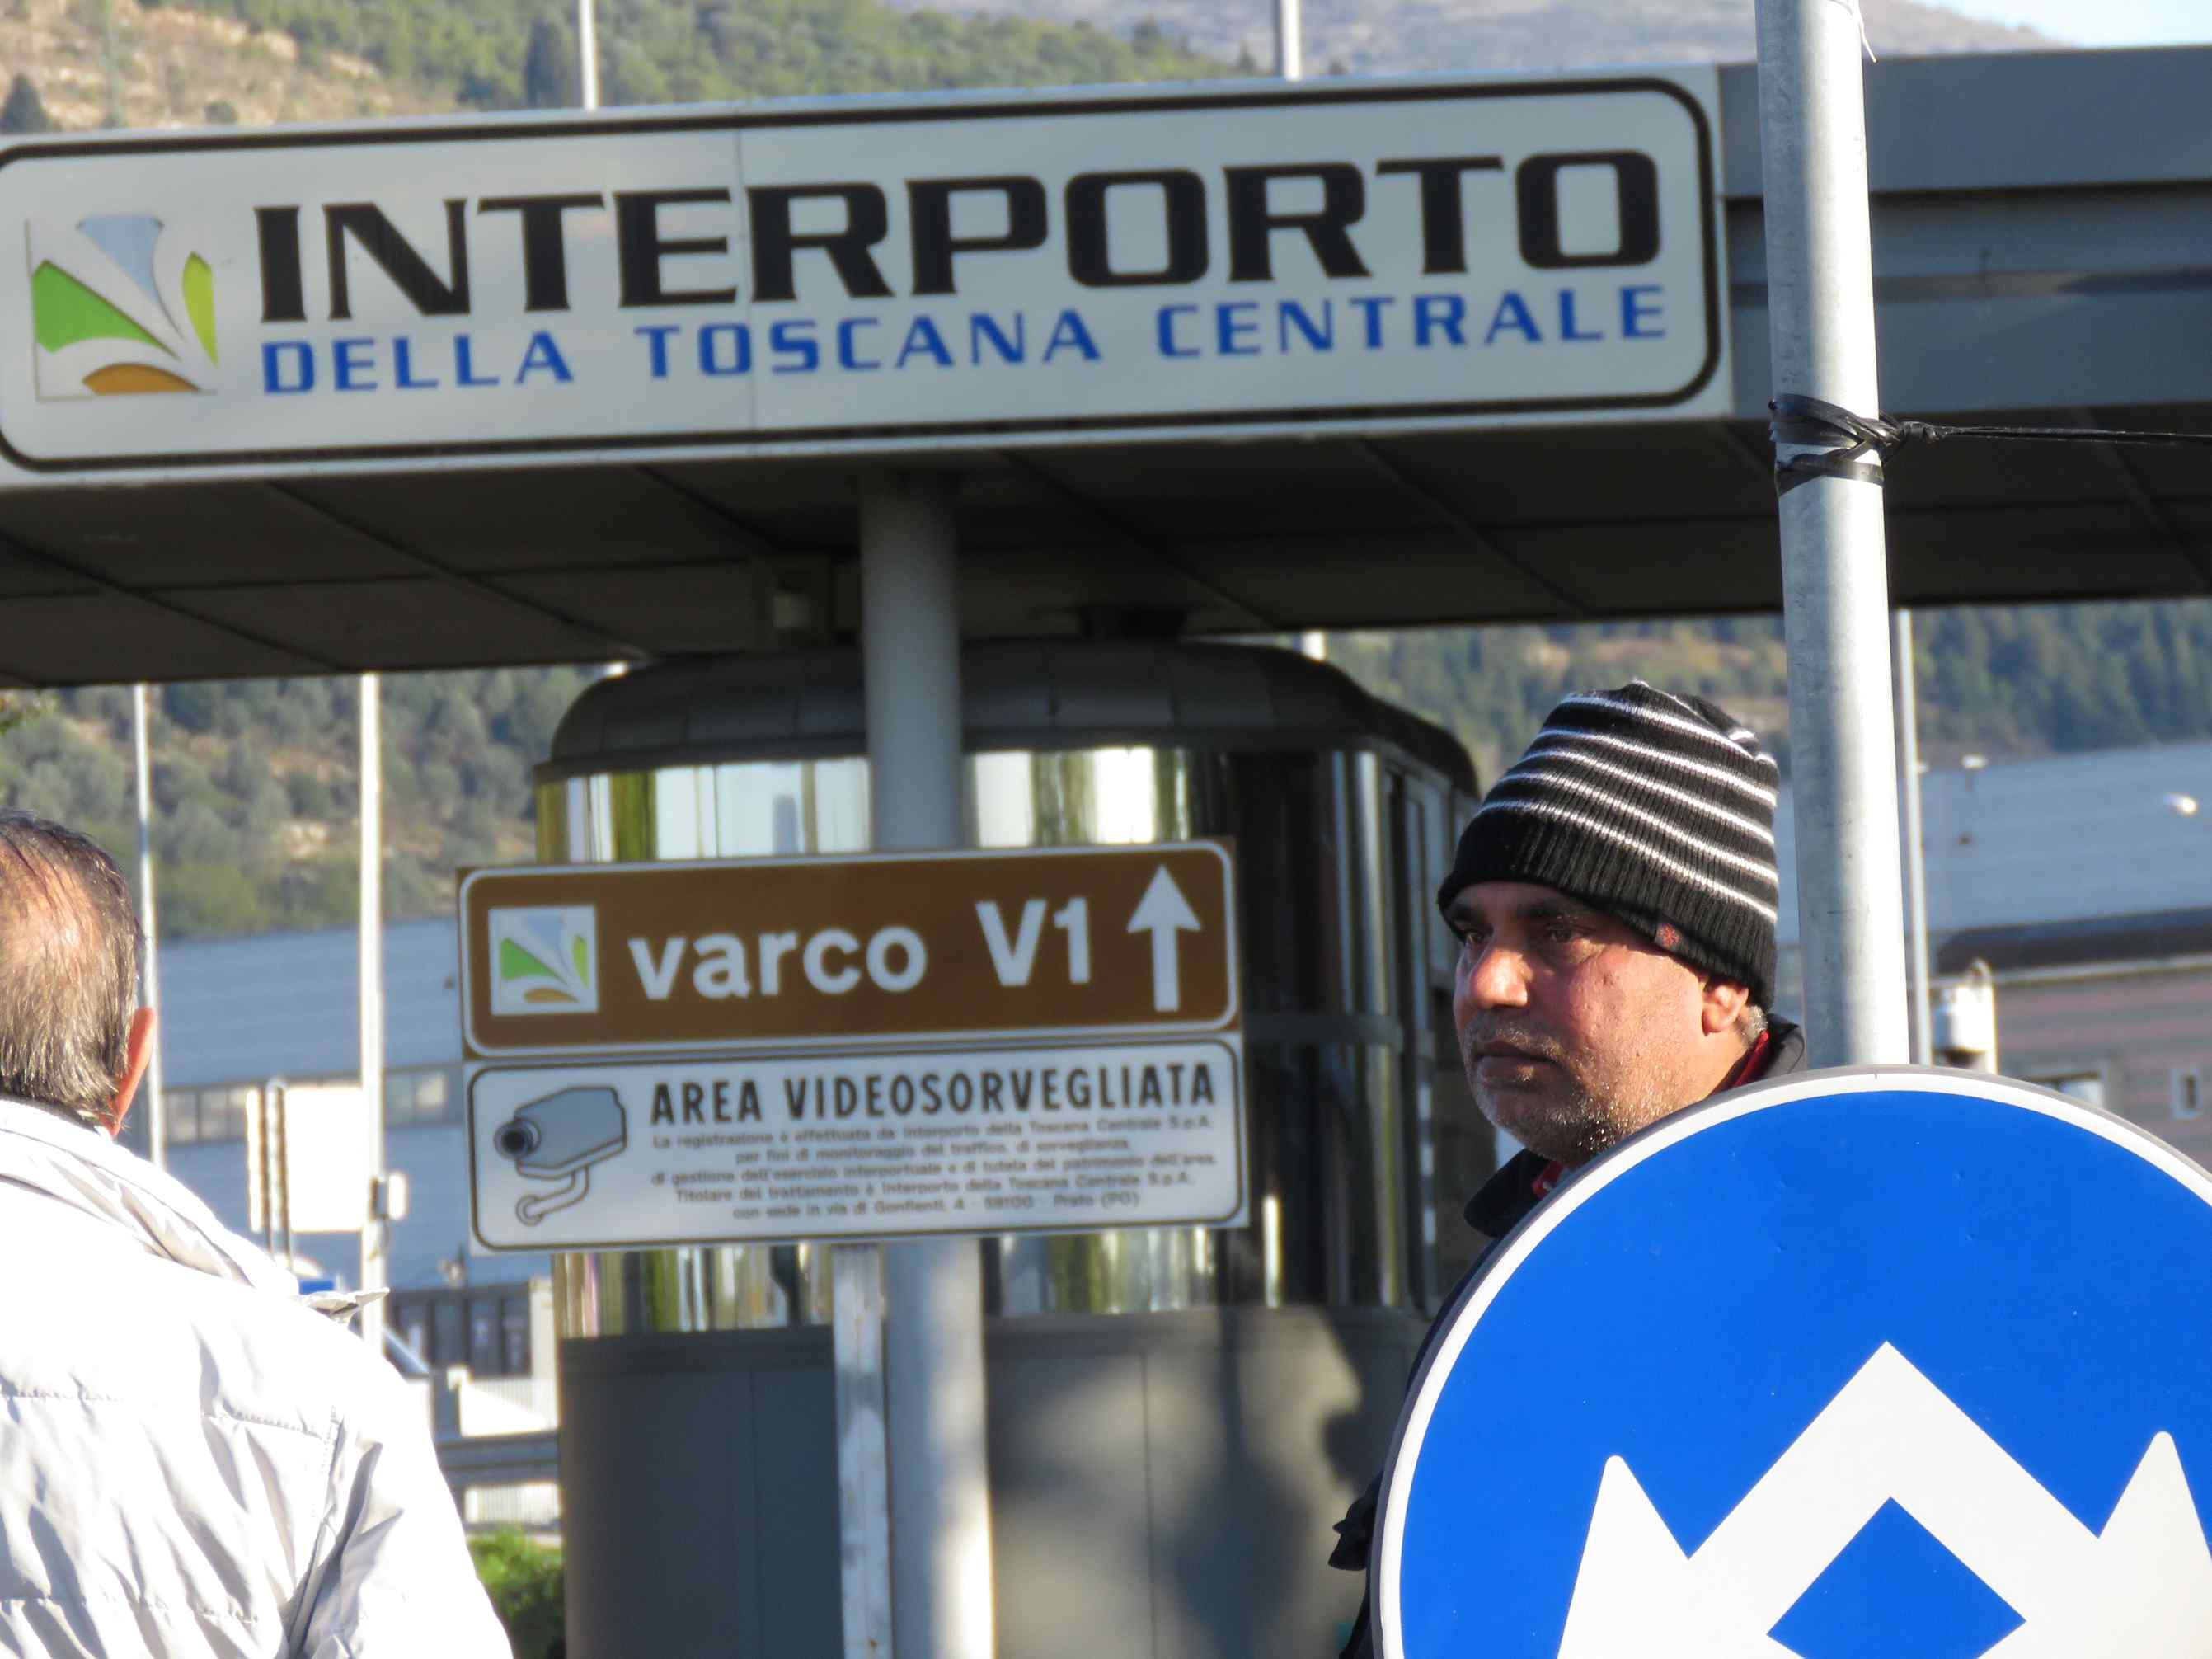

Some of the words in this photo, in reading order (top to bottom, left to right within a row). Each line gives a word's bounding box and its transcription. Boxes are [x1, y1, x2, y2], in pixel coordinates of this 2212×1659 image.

[254, 148, 1661, 324] INTERPORTO
[262, 331, 574, 395] DELLA
[634, 309, 1102, 380] TOSCANA
[1157, 284, 1667, 358] CENTRALE
[628, 926, 928, 1001] varco
[975, 896, 1094, 988] V1
[650, 1080, 762, 1125] AREA
[785, 1064, 1214, 1119] VIDEOSORVEGLIATA
[653, 1135, 670, 1149] La
[878, 1127, 894, 1139] da
[988, 1123, 1021, 1135] della
[735, 1153, 759, 1165] per
[651, 1171, 665, 1186] di
[671, 1171, 734, 1186] gestione
